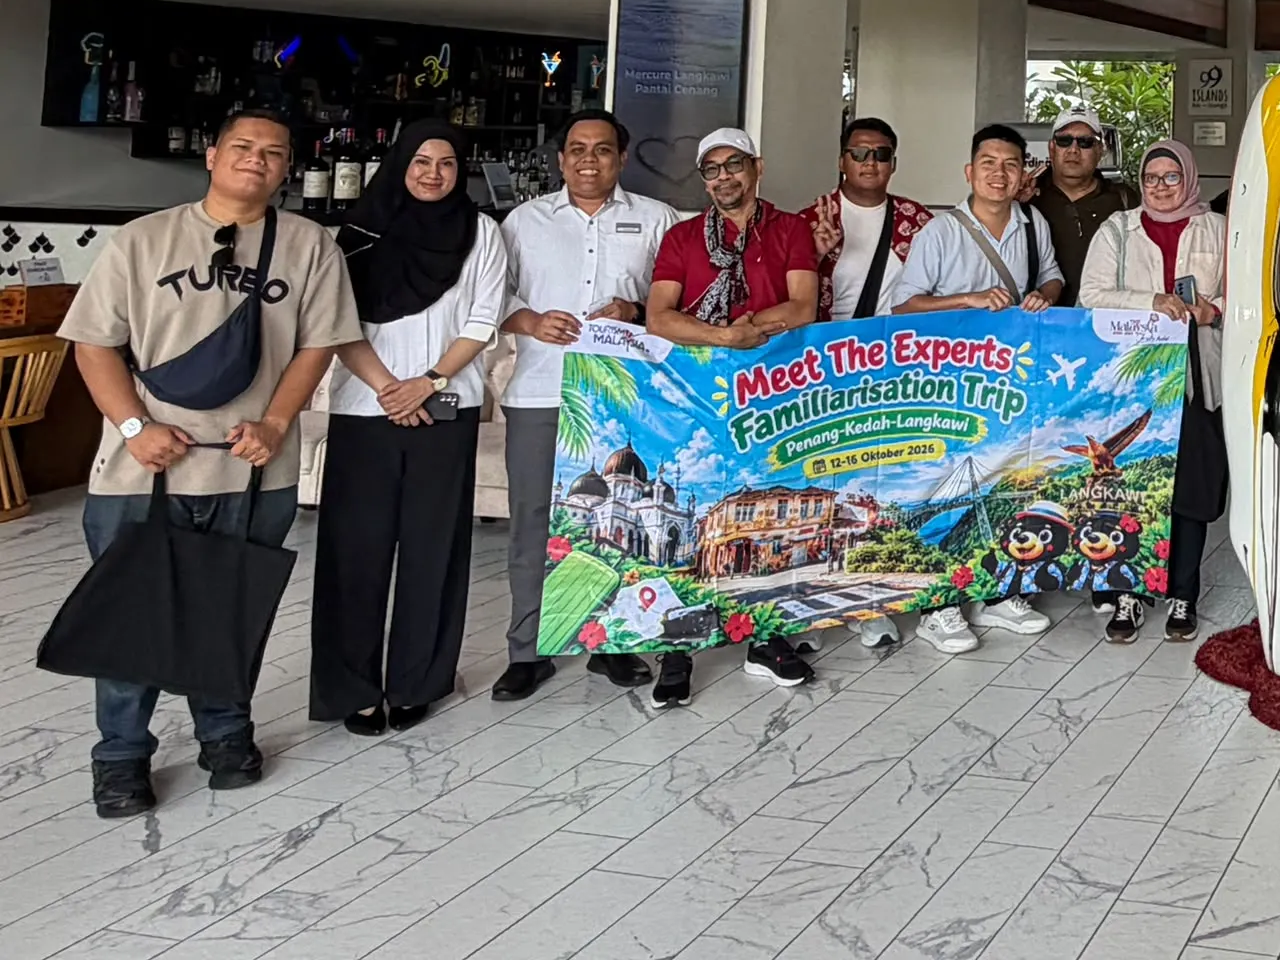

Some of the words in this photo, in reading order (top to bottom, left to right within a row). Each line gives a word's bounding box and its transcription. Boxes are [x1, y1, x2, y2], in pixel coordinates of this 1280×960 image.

[625, 69, 672, 80] Mercure
[674, 70, 730, 83] Langkawi
[1200, 65, 1222, 88] 99
[635, 83, 671, 94] Pantai
[674, 85, 718, 96] Cenang
[1192, 89, 1228, 102] ISLANDS
[736, 348, 823, 407] Meet
[826, 338, 885, 375] The
[893, 332, 1013, 371] Experts
[730, 370, 955, 452] Familiarisation
[963, 374, 1025, 422] Trip
[786, 414, 970, 457] Penang-Kedah-Langkawi
[830, 455, 858, 468] 12-16
[861, 447, 904, 463] Oktober
[908, 444, 935, 455] 2026
